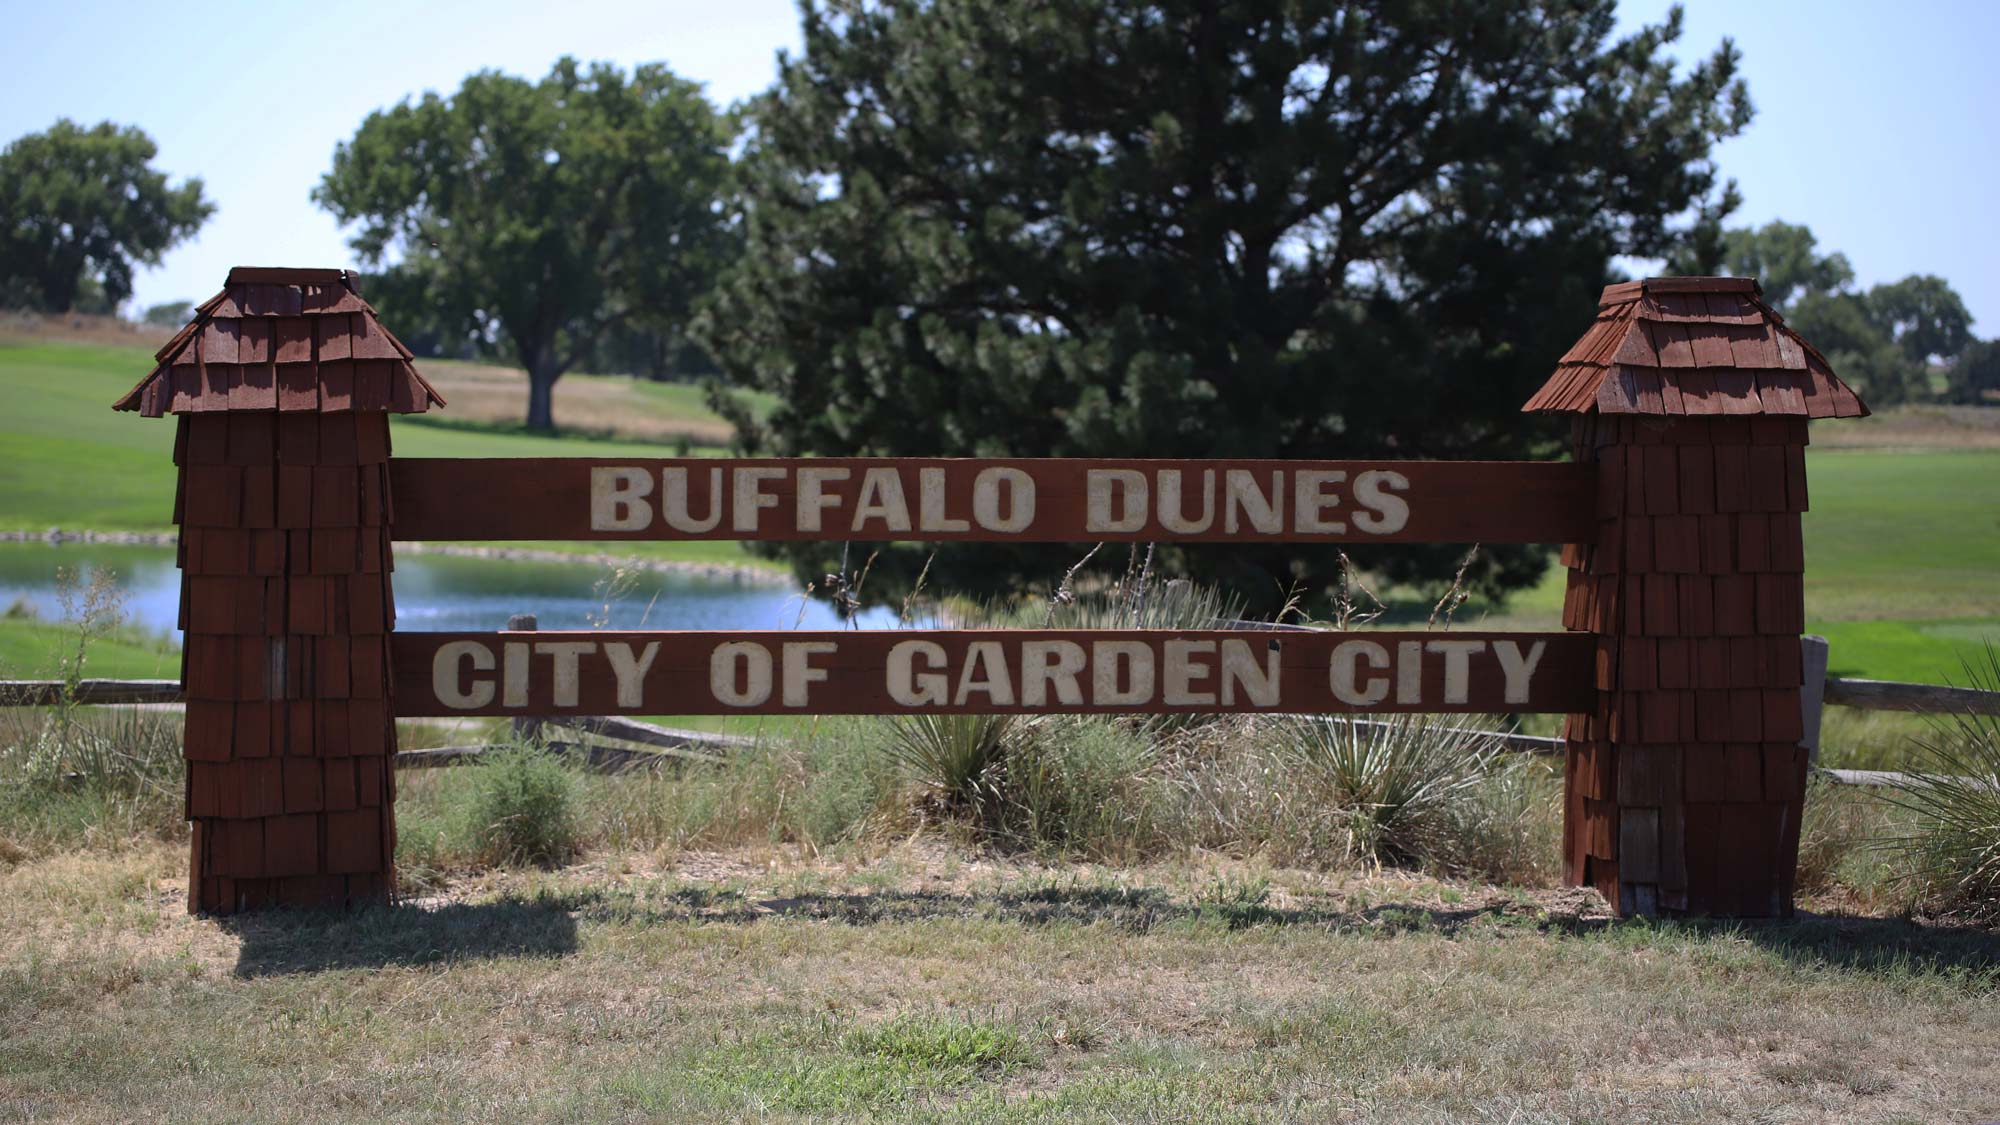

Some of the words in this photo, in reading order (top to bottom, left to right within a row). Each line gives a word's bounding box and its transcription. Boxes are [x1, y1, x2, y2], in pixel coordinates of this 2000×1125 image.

[590, 466, 1037, 533] BUFFALO
[1085, 468, 1410, 534] DUNES
[431, 640, 661, 709] CITY
[709, 641, 838, 707] OF
[885, 639, 1281, 707] GARDEN
[1329, 640, 1547, 706] CITY
